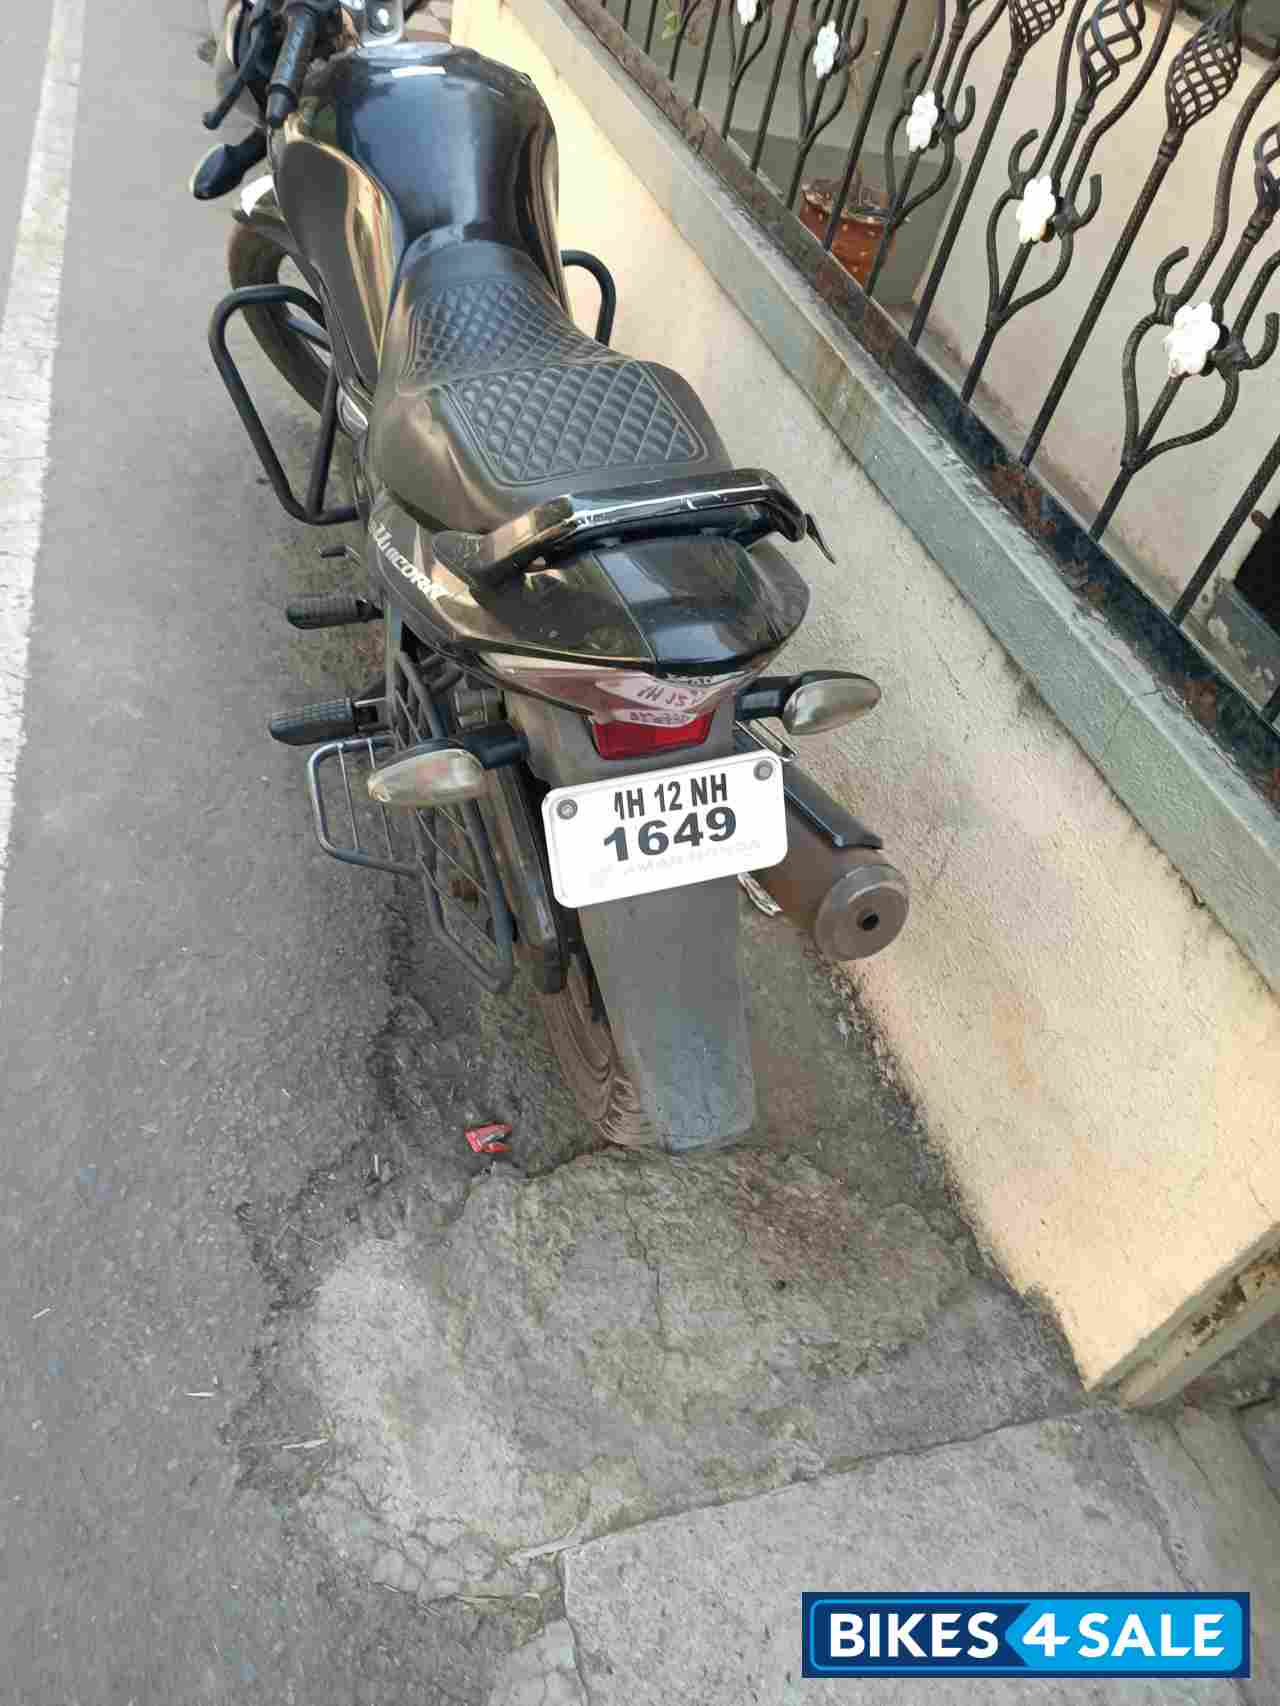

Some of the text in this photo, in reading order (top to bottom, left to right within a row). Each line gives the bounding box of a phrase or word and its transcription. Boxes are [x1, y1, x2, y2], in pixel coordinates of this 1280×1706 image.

[654, 781, 682, 813] 12
[690, 773, 728, 807] NH
[604, 806, 737, 862] 1649
